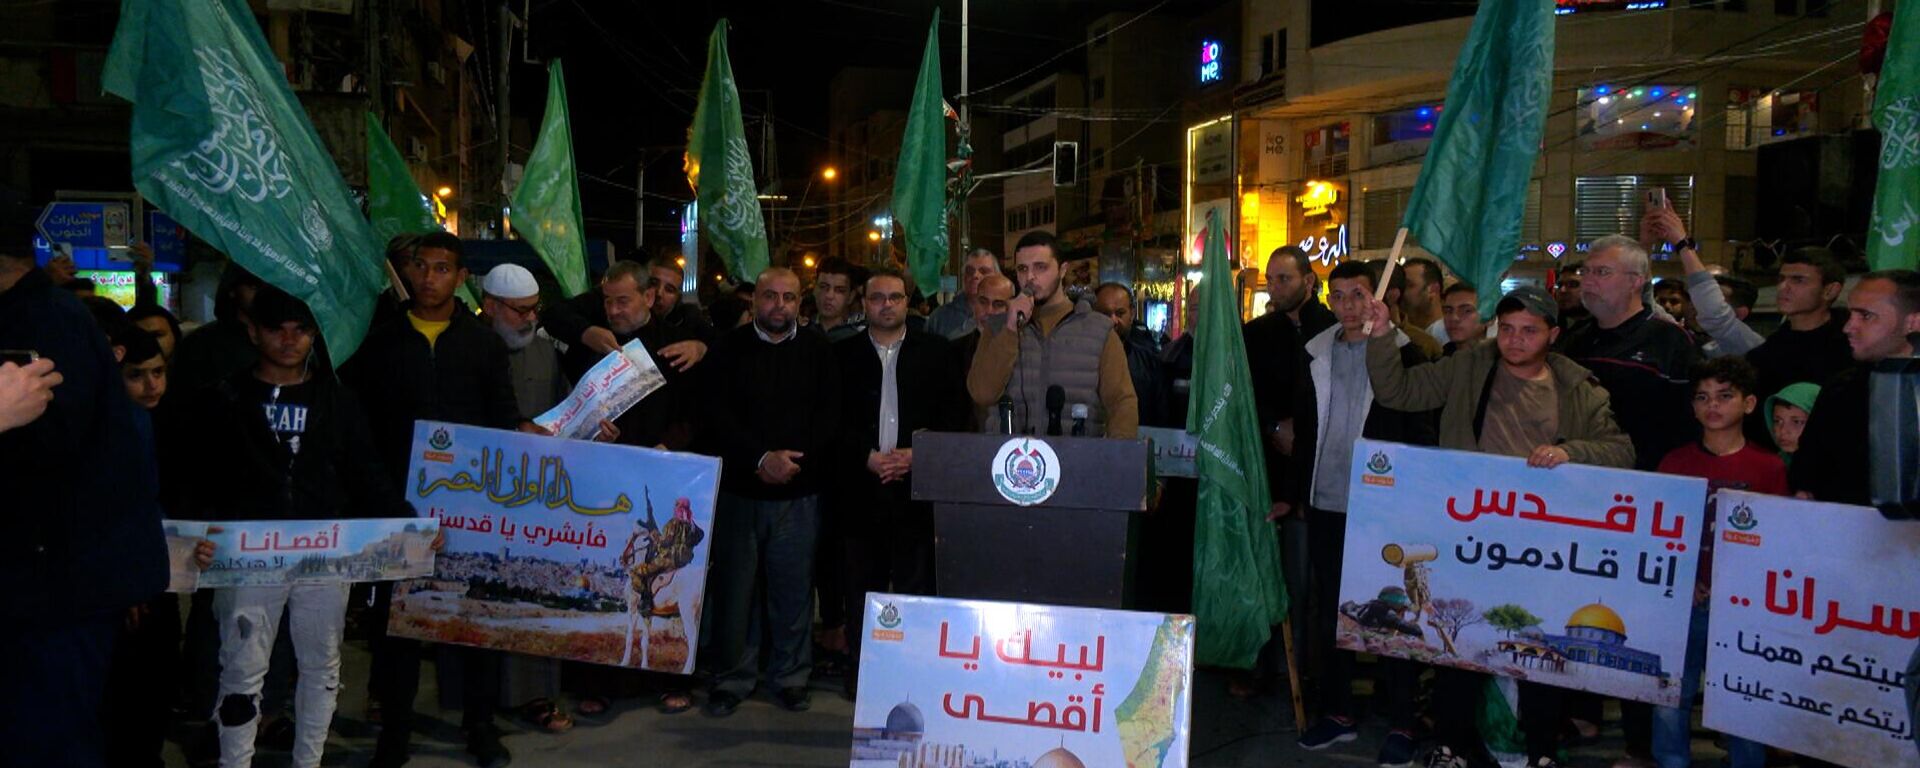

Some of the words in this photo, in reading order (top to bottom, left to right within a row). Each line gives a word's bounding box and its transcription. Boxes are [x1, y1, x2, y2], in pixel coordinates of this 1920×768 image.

[49, 213, 92, 226] سيارات
[50, 226, 92, 239] الجنوب
[263, 403, 309, 433] EAH
[1446, 488, 1638, 533] قدس
[1651, 500, 1687, 553] يا
[240, 523, 340, 552] أقصانا
[499, 515, 516, 541] يا
[523, 521, 608, 551] فأبشري
[209, 556, 267, 571] هيكله
[273, 555, 284, 569] لا
[1455, 535, 1620, 580] قادمون
[1637, 550, 1678, 599] إنا
[1765, 569, 1920, 640] سرانا
[939, 621, 981, 671] يا
[996, 629, 1105, 681] لبيك
[1737, 630, 1803, 666] همنا
[1723, 673, 1775, 702] علينا
[1779, 691, 1833, 716] عهد
[943, 684, 1105, 734] أقصى
[1838, 707, 1914, 741] ريتكم
